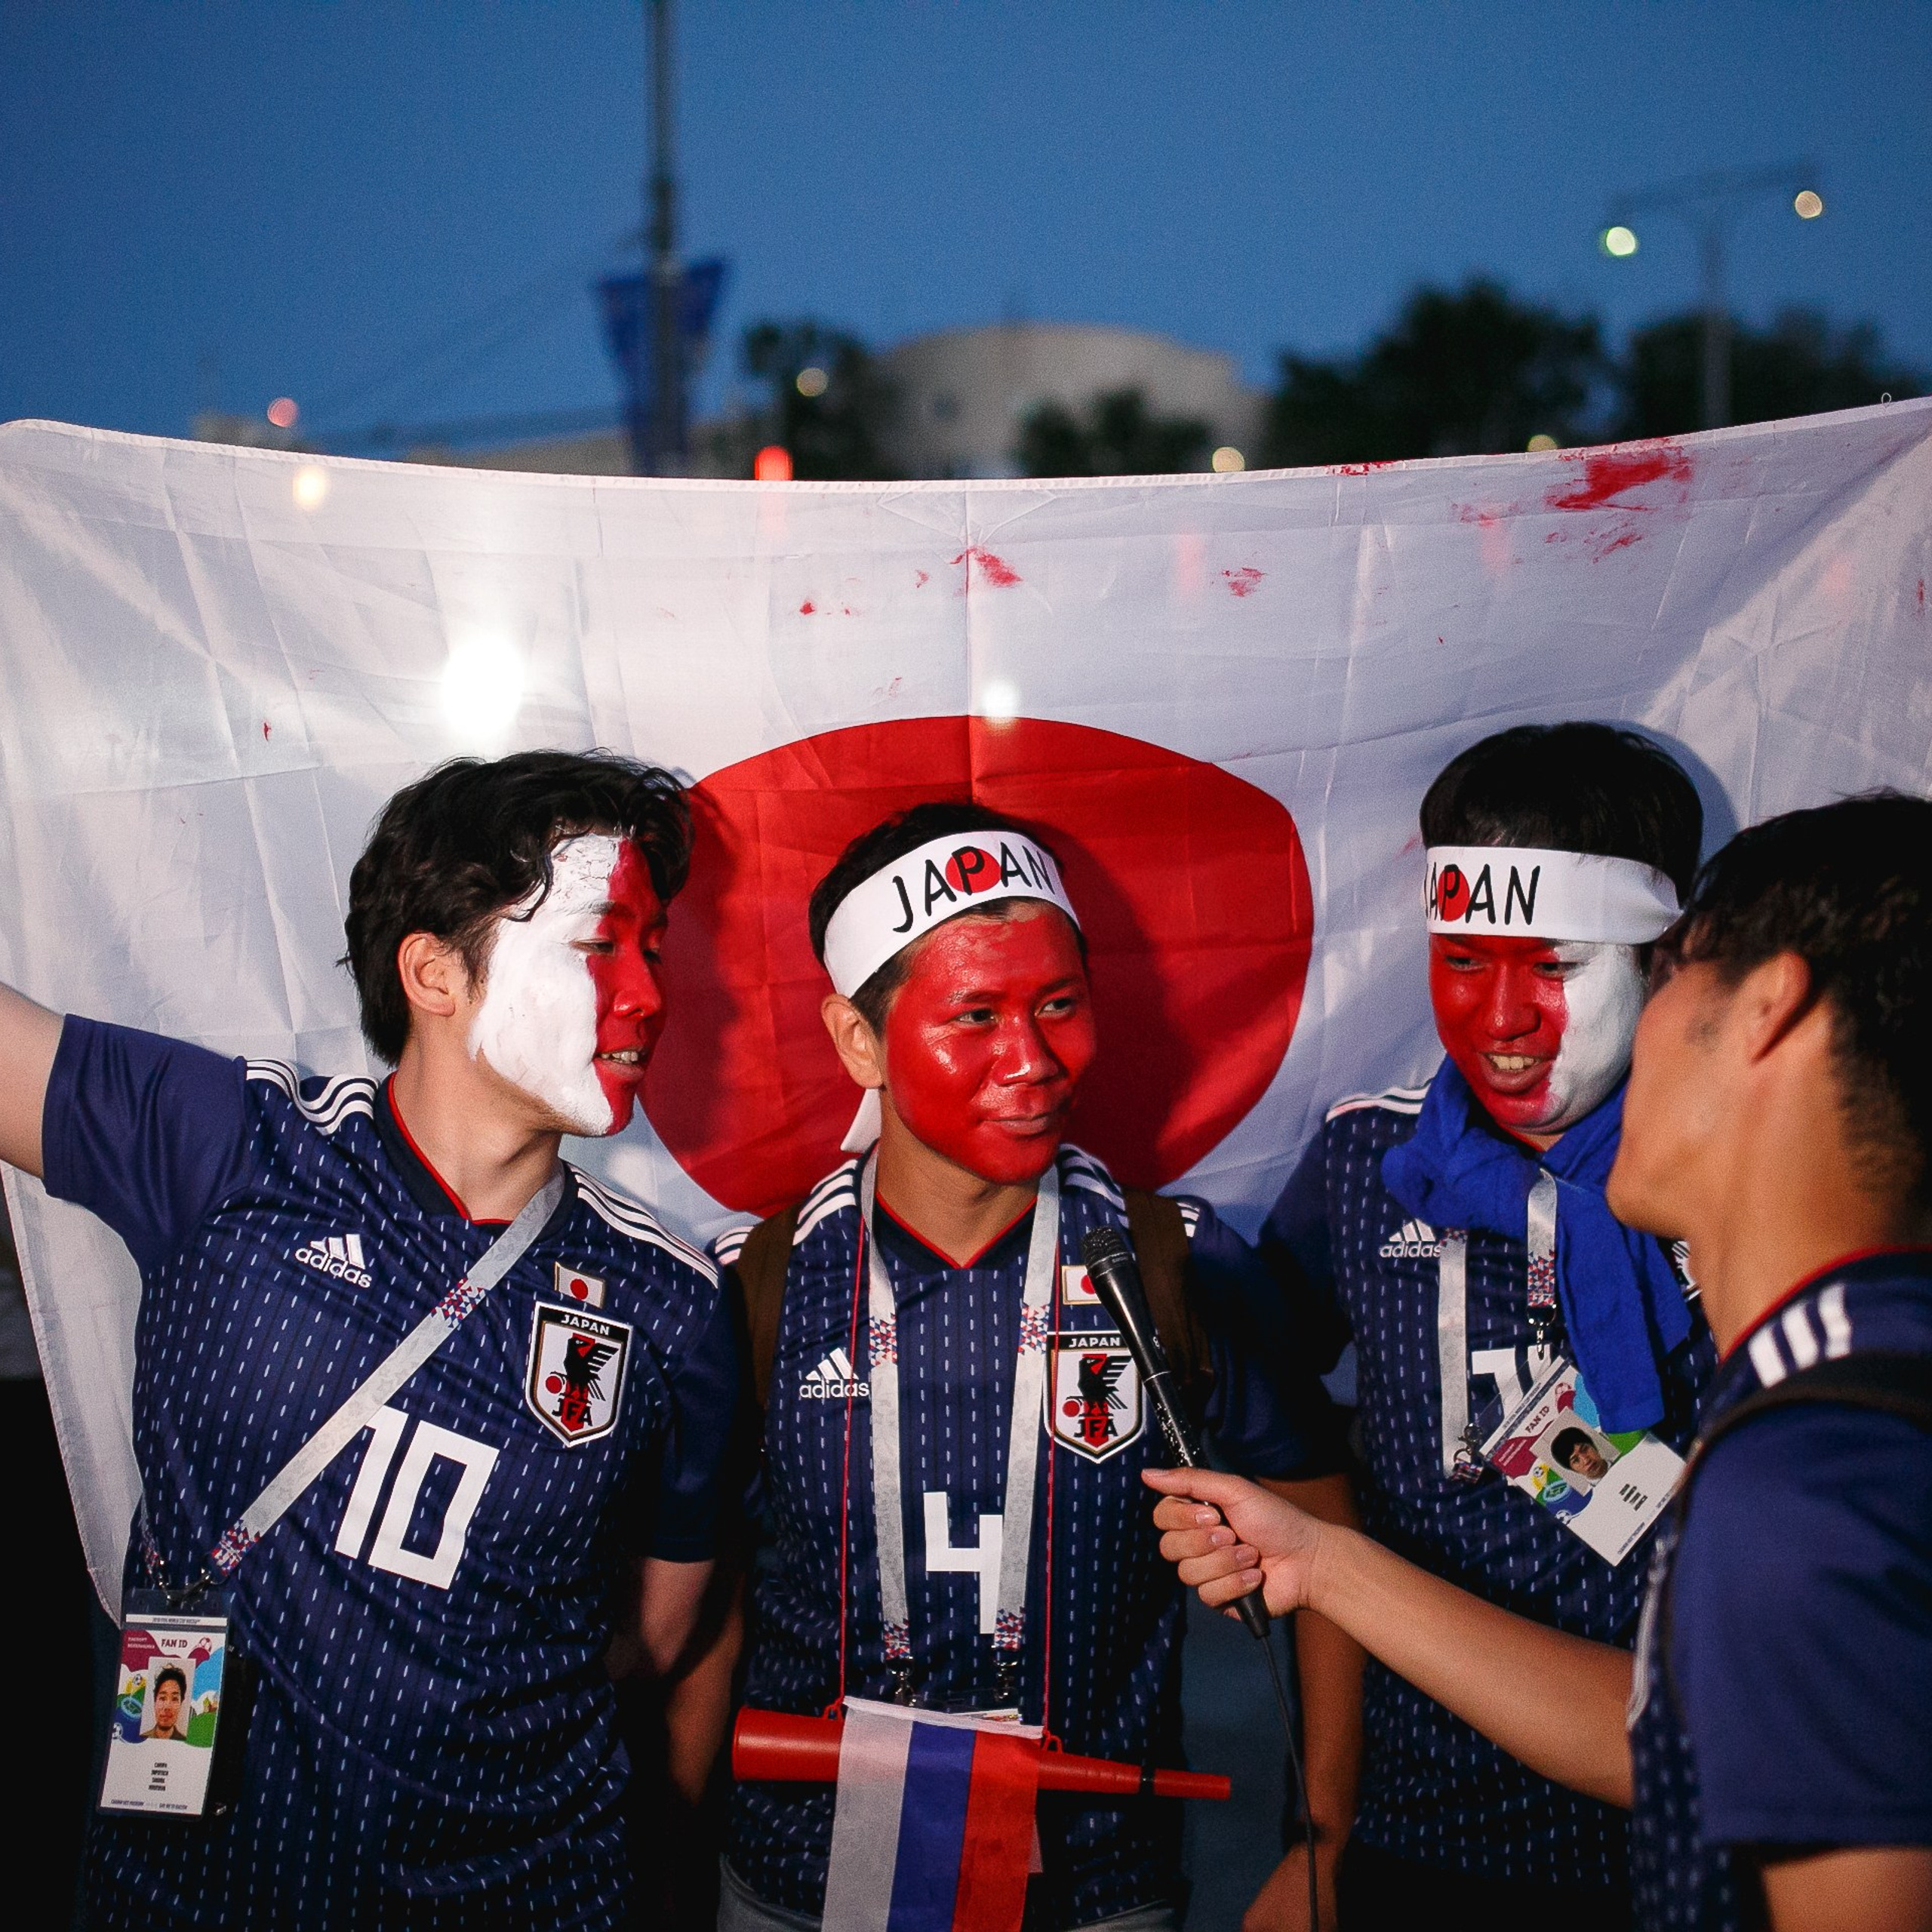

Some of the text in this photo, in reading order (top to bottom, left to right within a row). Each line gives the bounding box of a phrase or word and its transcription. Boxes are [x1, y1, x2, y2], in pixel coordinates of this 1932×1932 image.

[892, 841, 1056, 933] JAPAN
[1380, 1240, 1441, 1258] adidas
[295, 1247, 372, 1288] adidas
[561, 1314, 611, 1337] JAPAN
[1068, 1337, 1121, 1348] JAPAN
[799, 1380, 869, 1398] adidas
[552, 1398, 593, 1427] JFA
[1525, 1405, 1550, 1433] FAN ID
[1073, 1419, 1118, 1438] JFA
[334, 1404, 500, 1590] 10
[923, 1491, 1003, 1634] 4
[161, 1638, 177, 1647] FAN
[178, 1639, 188, 1648] ID
